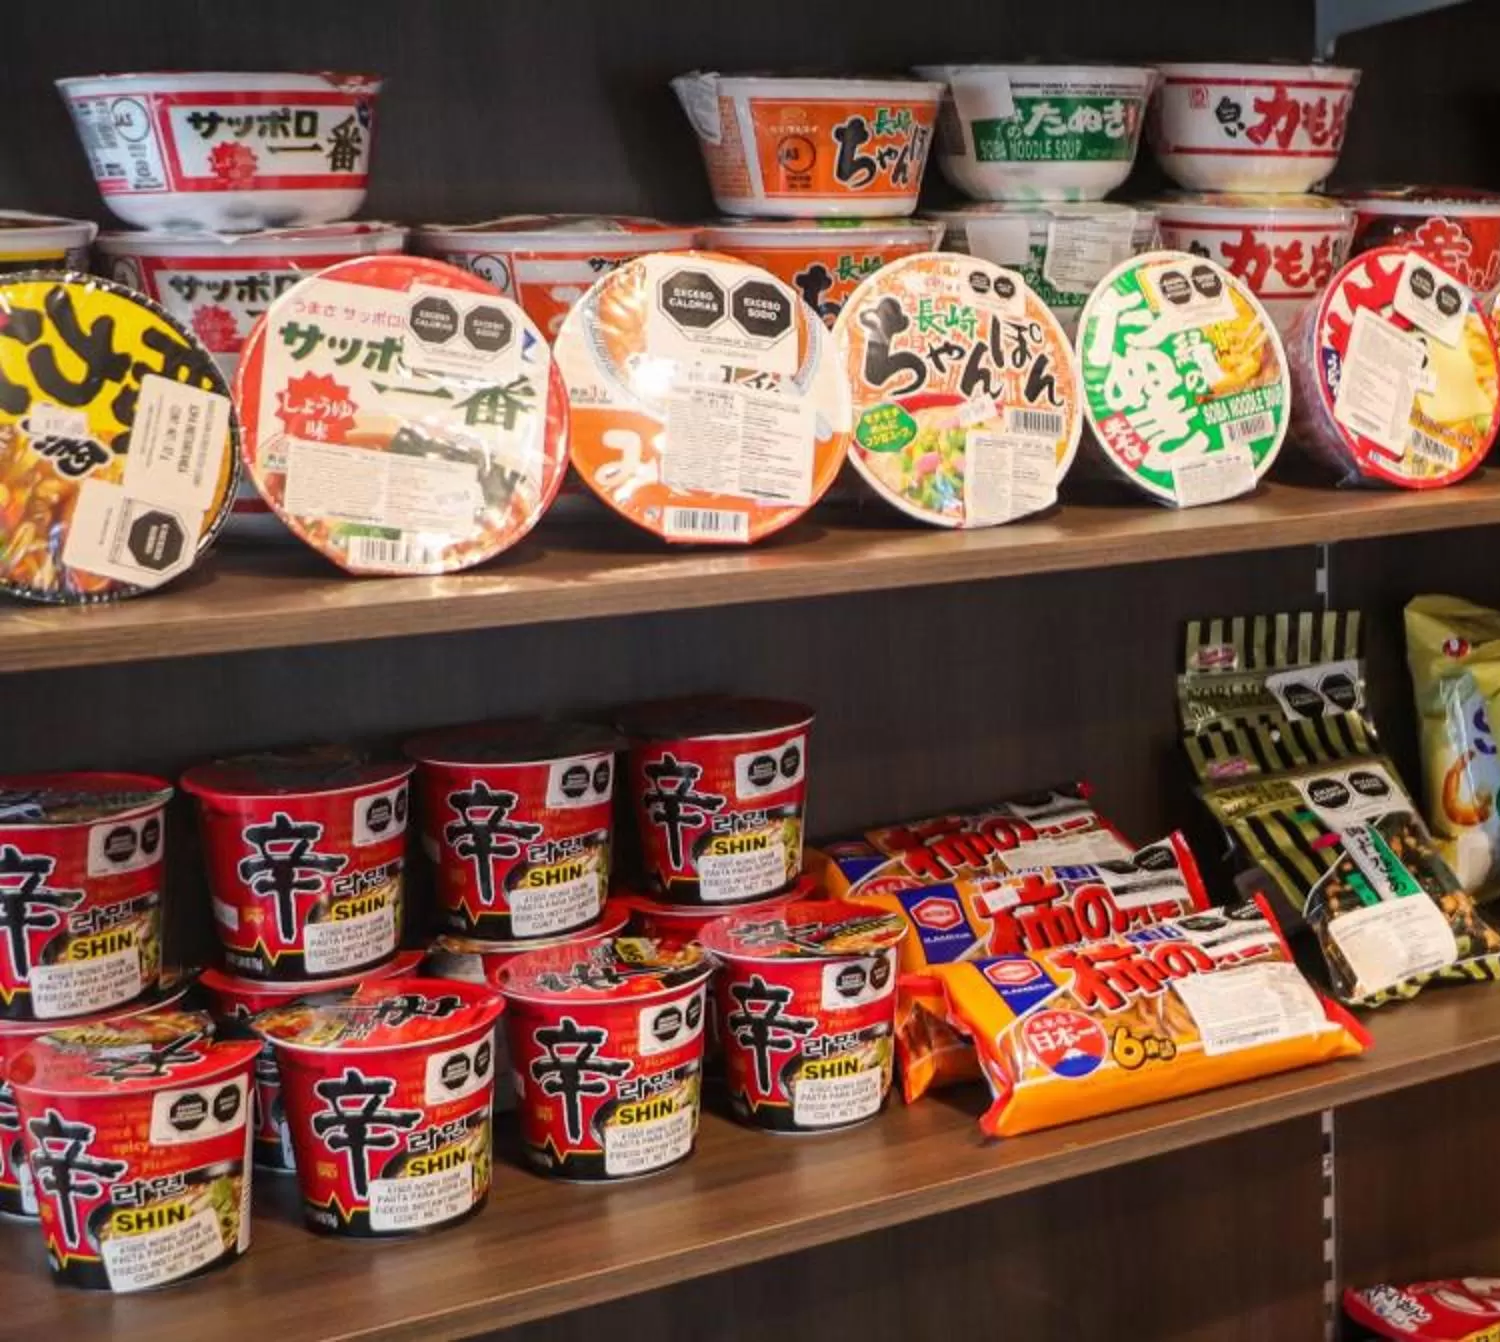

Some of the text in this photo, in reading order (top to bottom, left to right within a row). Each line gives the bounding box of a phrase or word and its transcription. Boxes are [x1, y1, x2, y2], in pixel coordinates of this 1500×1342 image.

[187, 110, 320, 140] サッポロ
[1010, 138, 1052, 159] NOODLE
[1055, 138, 1083, 160] SOUP
[668, 297, 719, 313] CALORIAS
[673, 287, 715, 302] EXCESO
[743, 297, 782, 313] EXCESO
[747, 308, 778, 321] SODIO
[915, 300, 979, 338] 長崎
[279, 321, 406, 373] サッポ
[859, 296, 1065, 408] ちゃんぽん
[369, 373, 537, 432] 一番
[643, 752, 727, 872] 辛
[711, 808, 769, 836] 라면
[444, 779, 544, 907] 辛
[528, 838, 585, 865] 라면
[714, 835, 768, 857] SHIN
[238, 812, 349, 944] 辛
[332, 865, 390, 898] 라면
[529, 864, 583, 888] SHIN
[69, 900, 136, 934] 라면
[335, 894, 386, 922] SHIN
[72, 931, 134, 961] SHIN
[728, 974, 818, 1096] 辛
[801, 1033, 860, 1059] 라면
[531, 1016, 634, 1144] 辛
[616, 1068, 676, 1100] 라면
[805, 1058, 859, 1080] SHIN
[619, 1097, 674, 1125] SHIN
[311, 1066, 424, 1201] 辛
[406, 1118, 467, 1153] 라면
[27, 1108, 128, 1248] 辛
[409, 1148, 468, 1178] SHIN
[110, 1173, 187, 1206] 라면
[116, 1203, 188, 1232] SHIN
